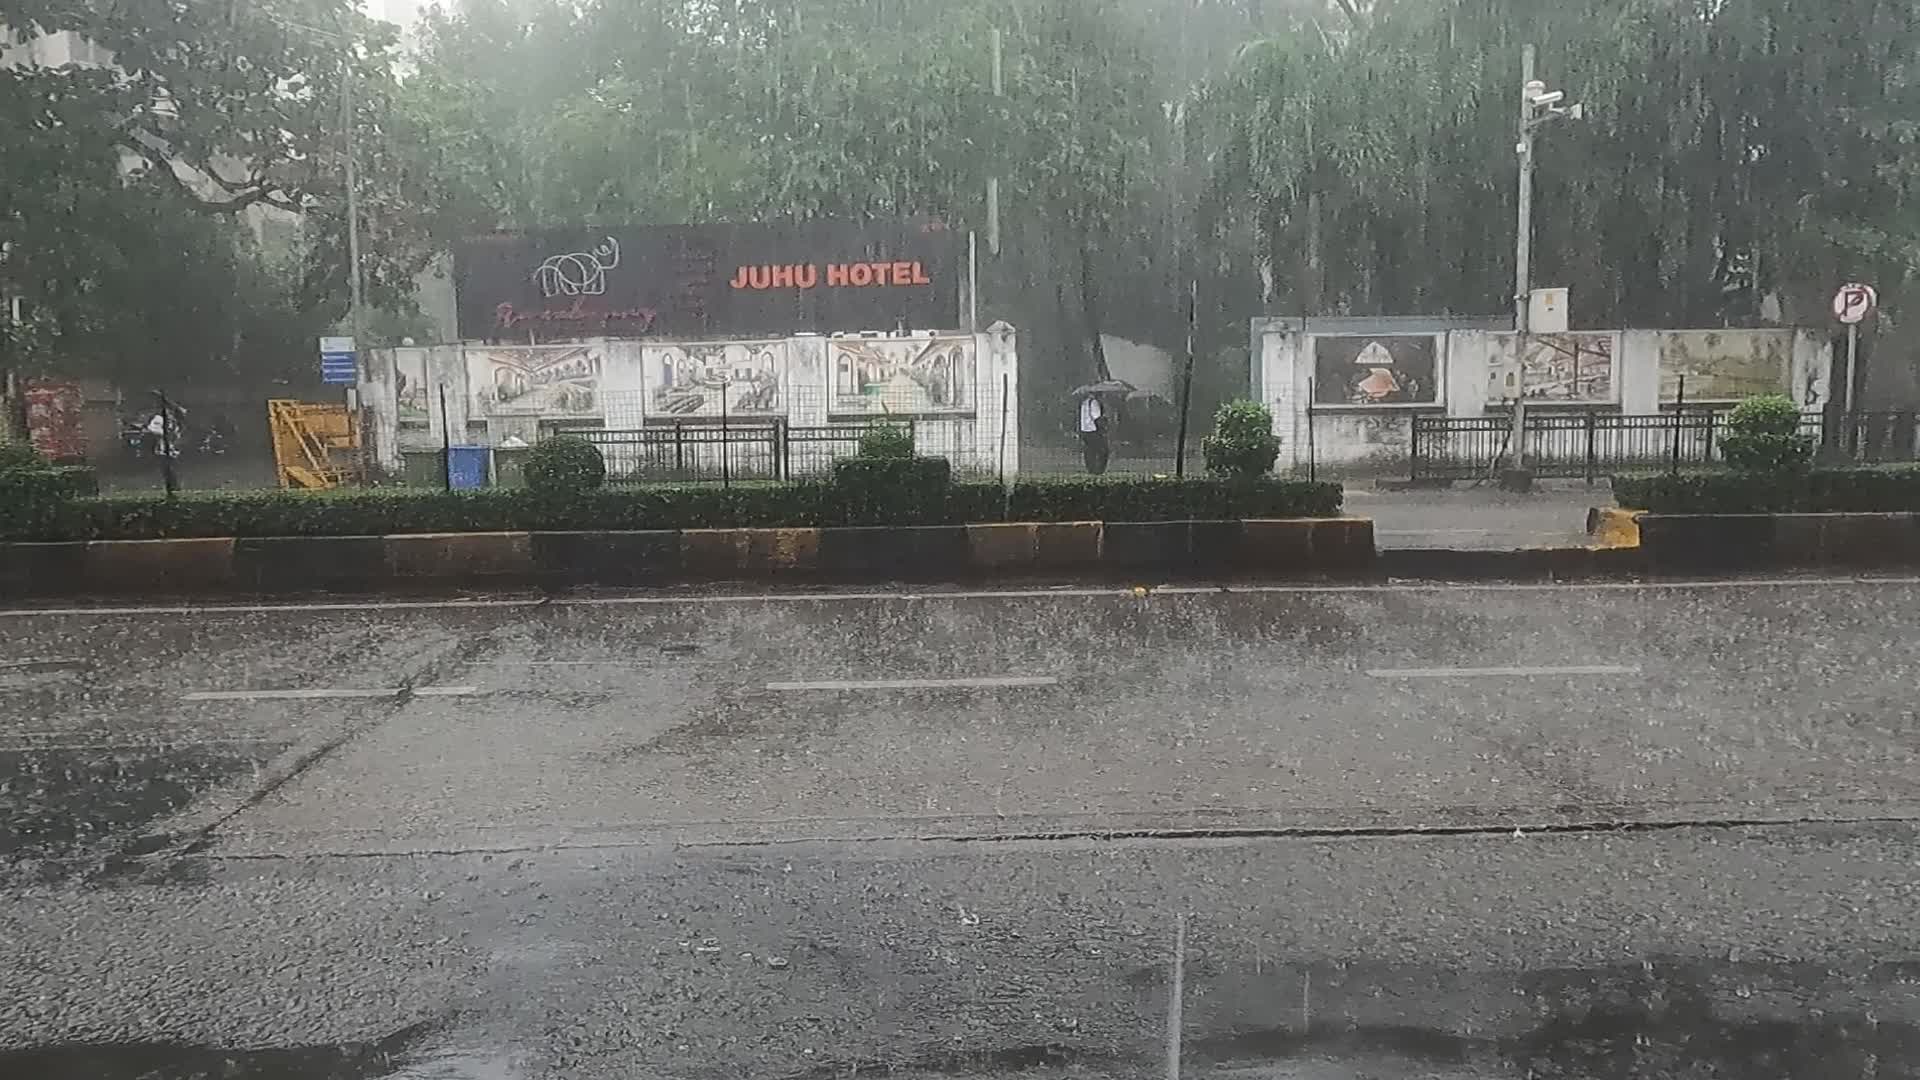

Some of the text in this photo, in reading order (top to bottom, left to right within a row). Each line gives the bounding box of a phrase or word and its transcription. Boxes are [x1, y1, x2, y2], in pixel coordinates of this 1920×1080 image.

[730, 261, 930, 289] JUHU HOTEL
[1844, 290, 1865, 317] P
